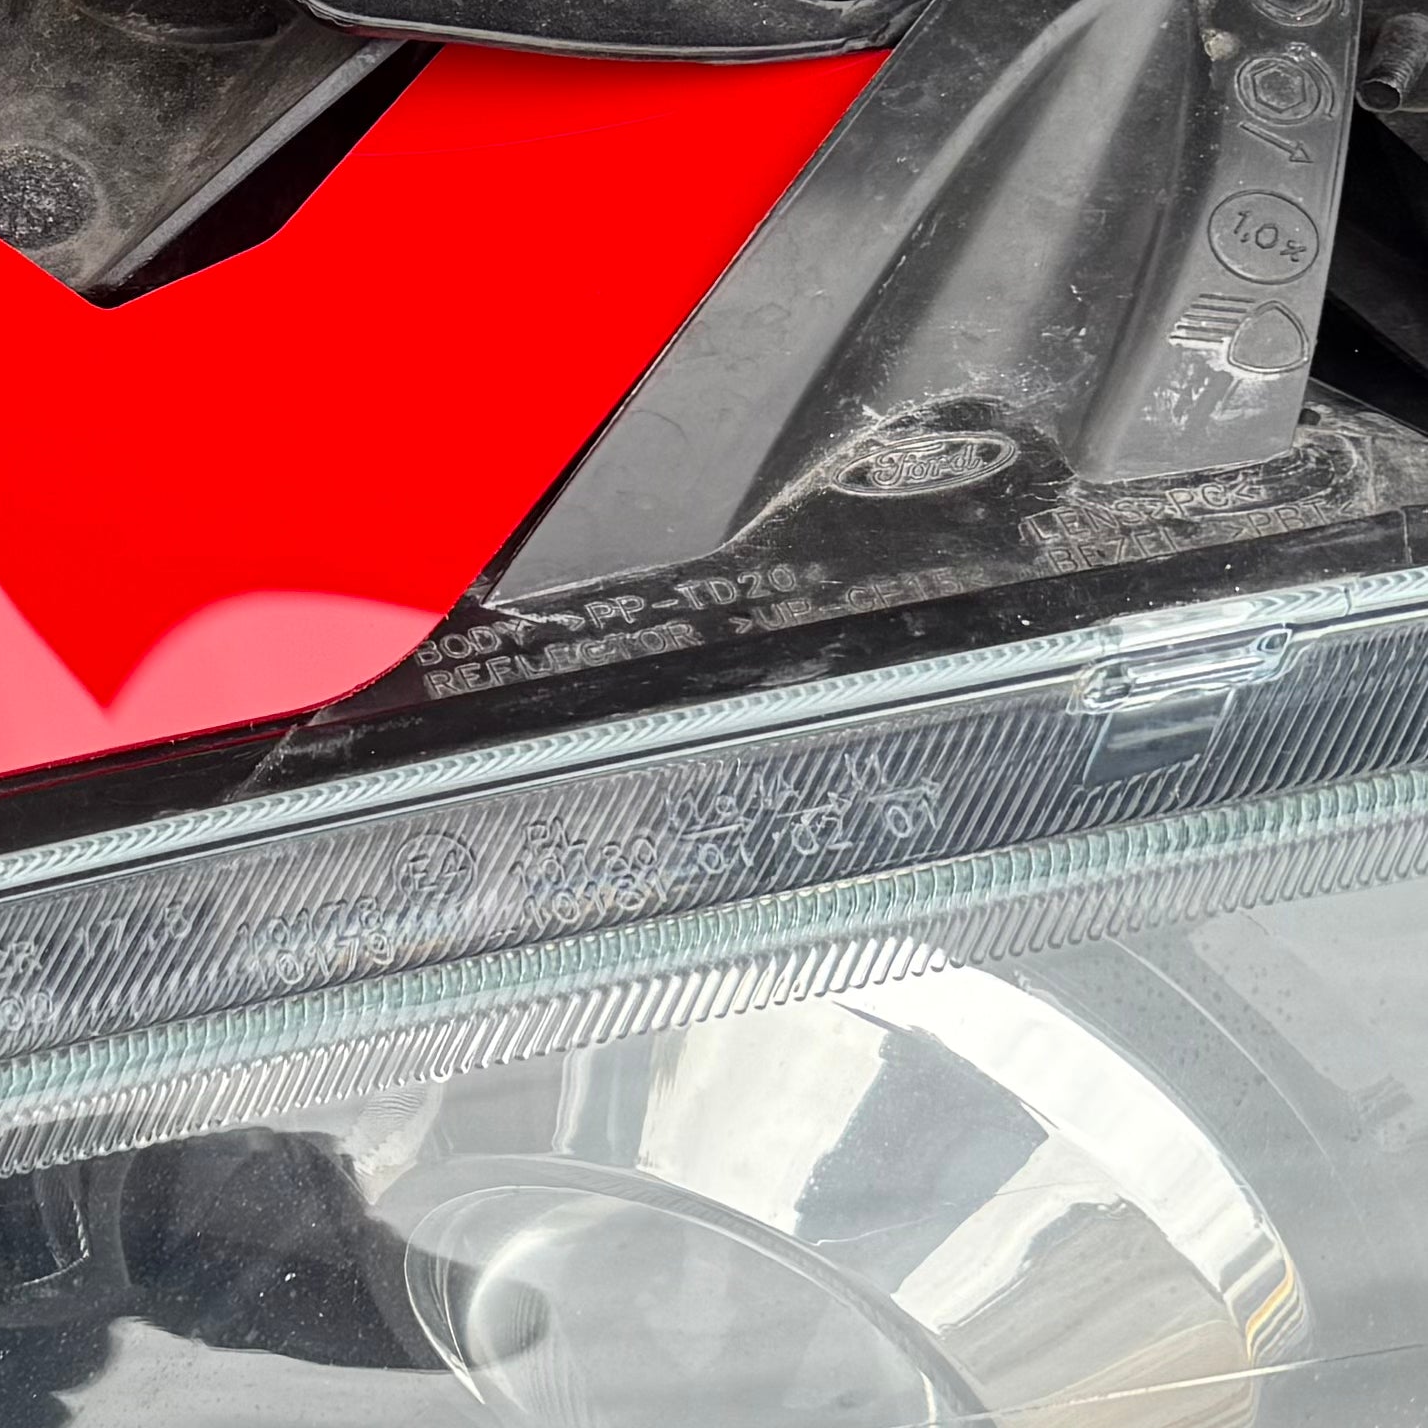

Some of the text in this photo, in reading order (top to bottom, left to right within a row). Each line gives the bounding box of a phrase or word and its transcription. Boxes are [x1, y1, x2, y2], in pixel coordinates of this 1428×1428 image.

[870, 440, 984, 488] Ford
[415, 620, 538, 667] BODY
[424, 621, 704, 700] REFLECTOR
